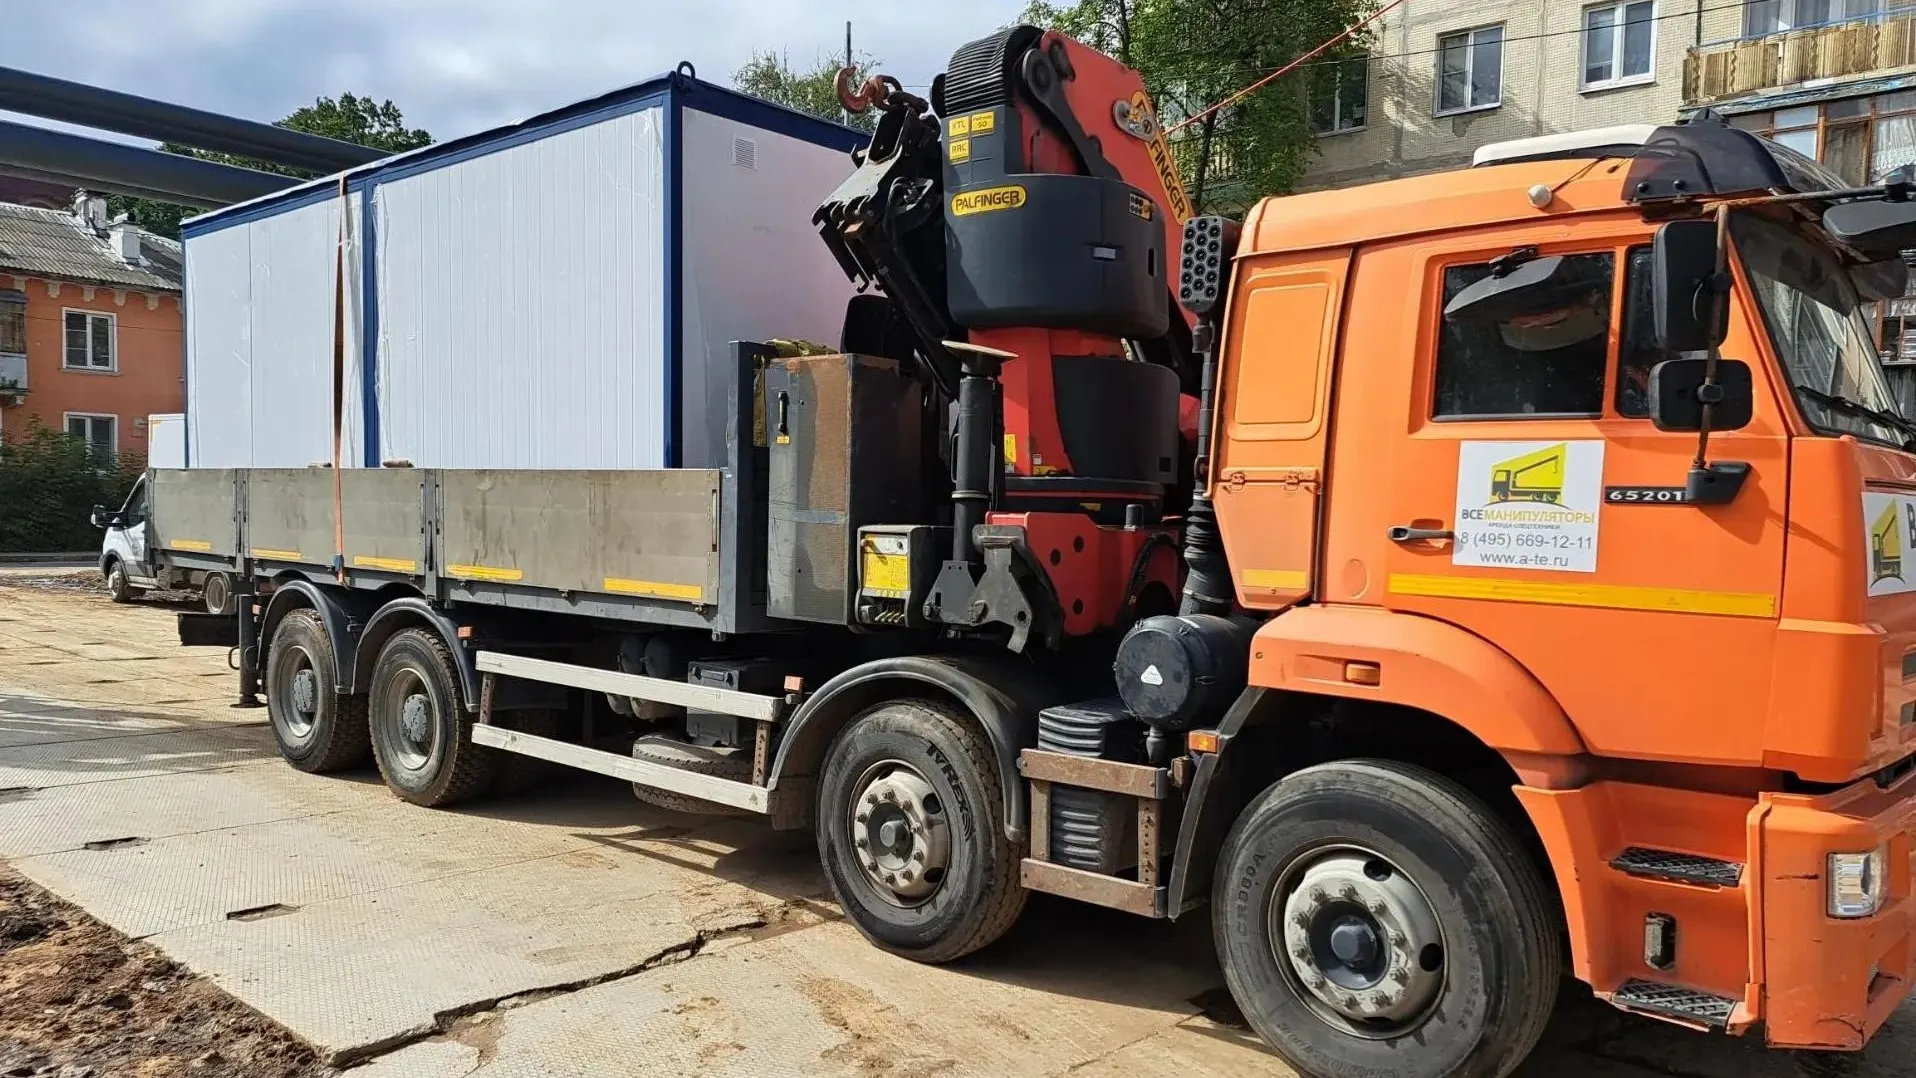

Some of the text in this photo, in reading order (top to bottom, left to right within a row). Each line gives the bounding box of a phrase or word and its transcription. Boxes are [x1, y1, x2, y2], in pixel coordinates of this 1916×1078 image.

[955, 190, 1020, 212] PALFINGER
[1609, 490, 1683, 501] 65201
[1461, 509, 1595, 524] ВСЕМАНИПУЛЯТОРЫ
[1460, 531, 1592, 550] 8 (495) 669-12-11
[1480, 552, 1569, 567] www.a-te.ru
